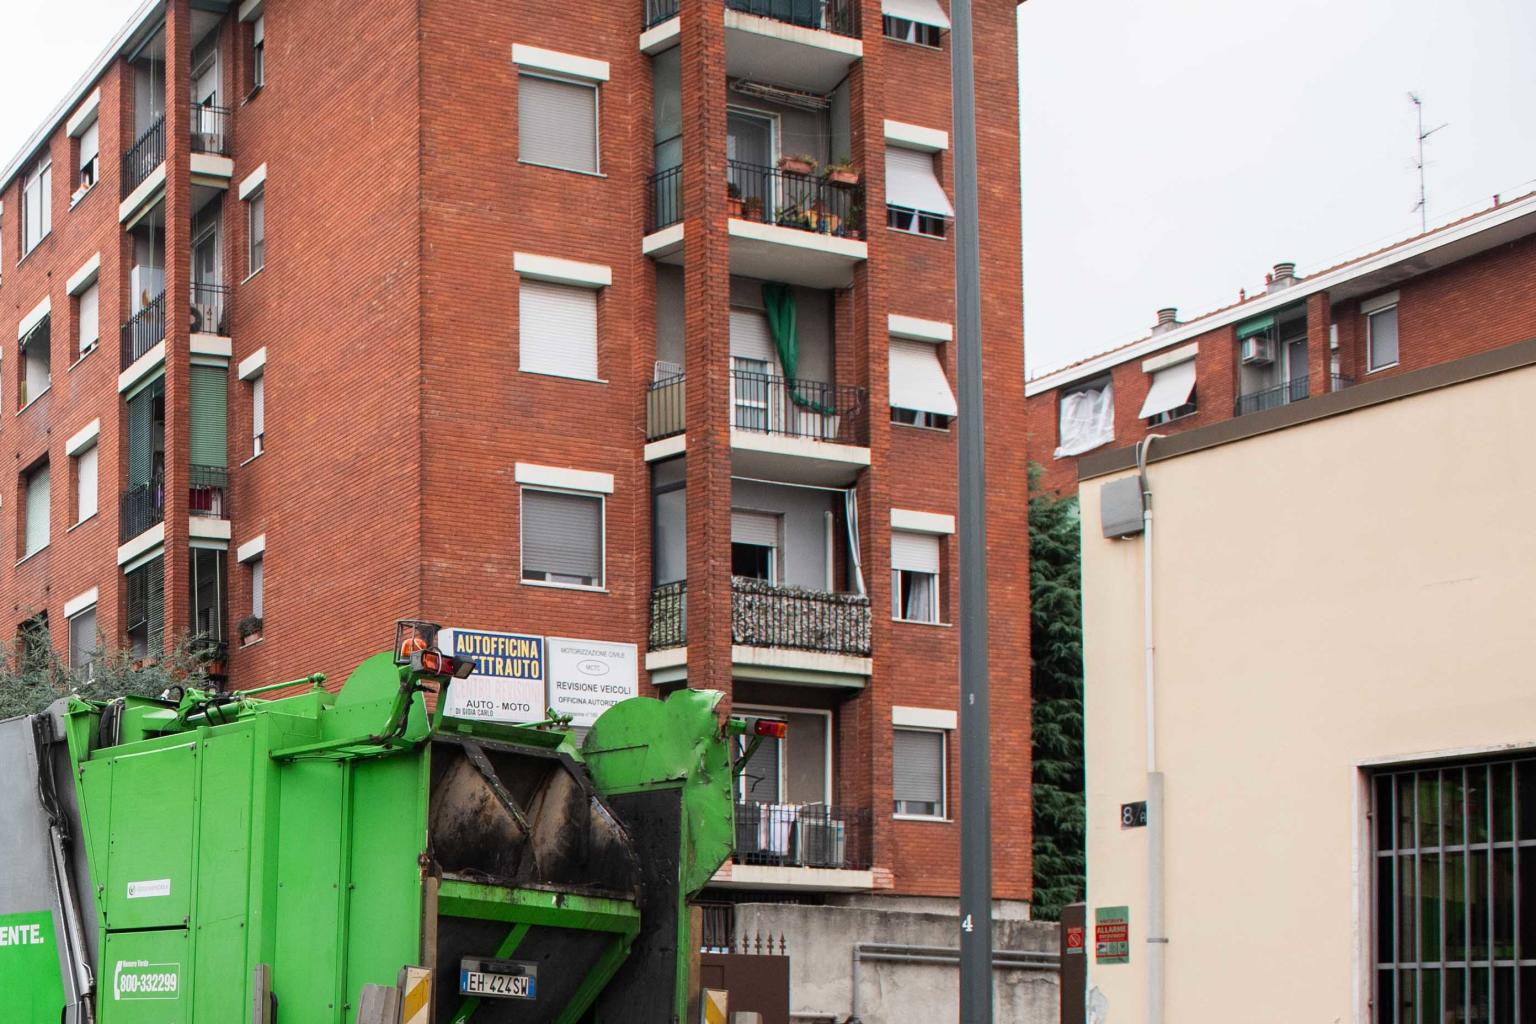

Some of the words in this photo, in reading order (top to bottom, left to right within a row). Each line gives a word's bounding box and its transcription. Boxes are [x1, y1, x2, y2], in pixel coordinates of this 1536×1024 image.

[456, 633, 539, 658] AUTOFFICINA
[472, 656, 540, 679] ETTRAUTO
[556, 681, 599, 693] REVISIONE
[600, 685, 632, 695] VEICOLI
[466, 699, 494, 710] AUTO
[501, 703, 531, 712] MOTO
[558, 696, 587, 705] OFFICINA
[477, 709, 494, 717] CARLO
[961, 914, 974, 932] 4
[120, 973, 177, 992] 800-332299
[469, 974, 485, 991] EH
[489, 976, 528, 995] 424SW
